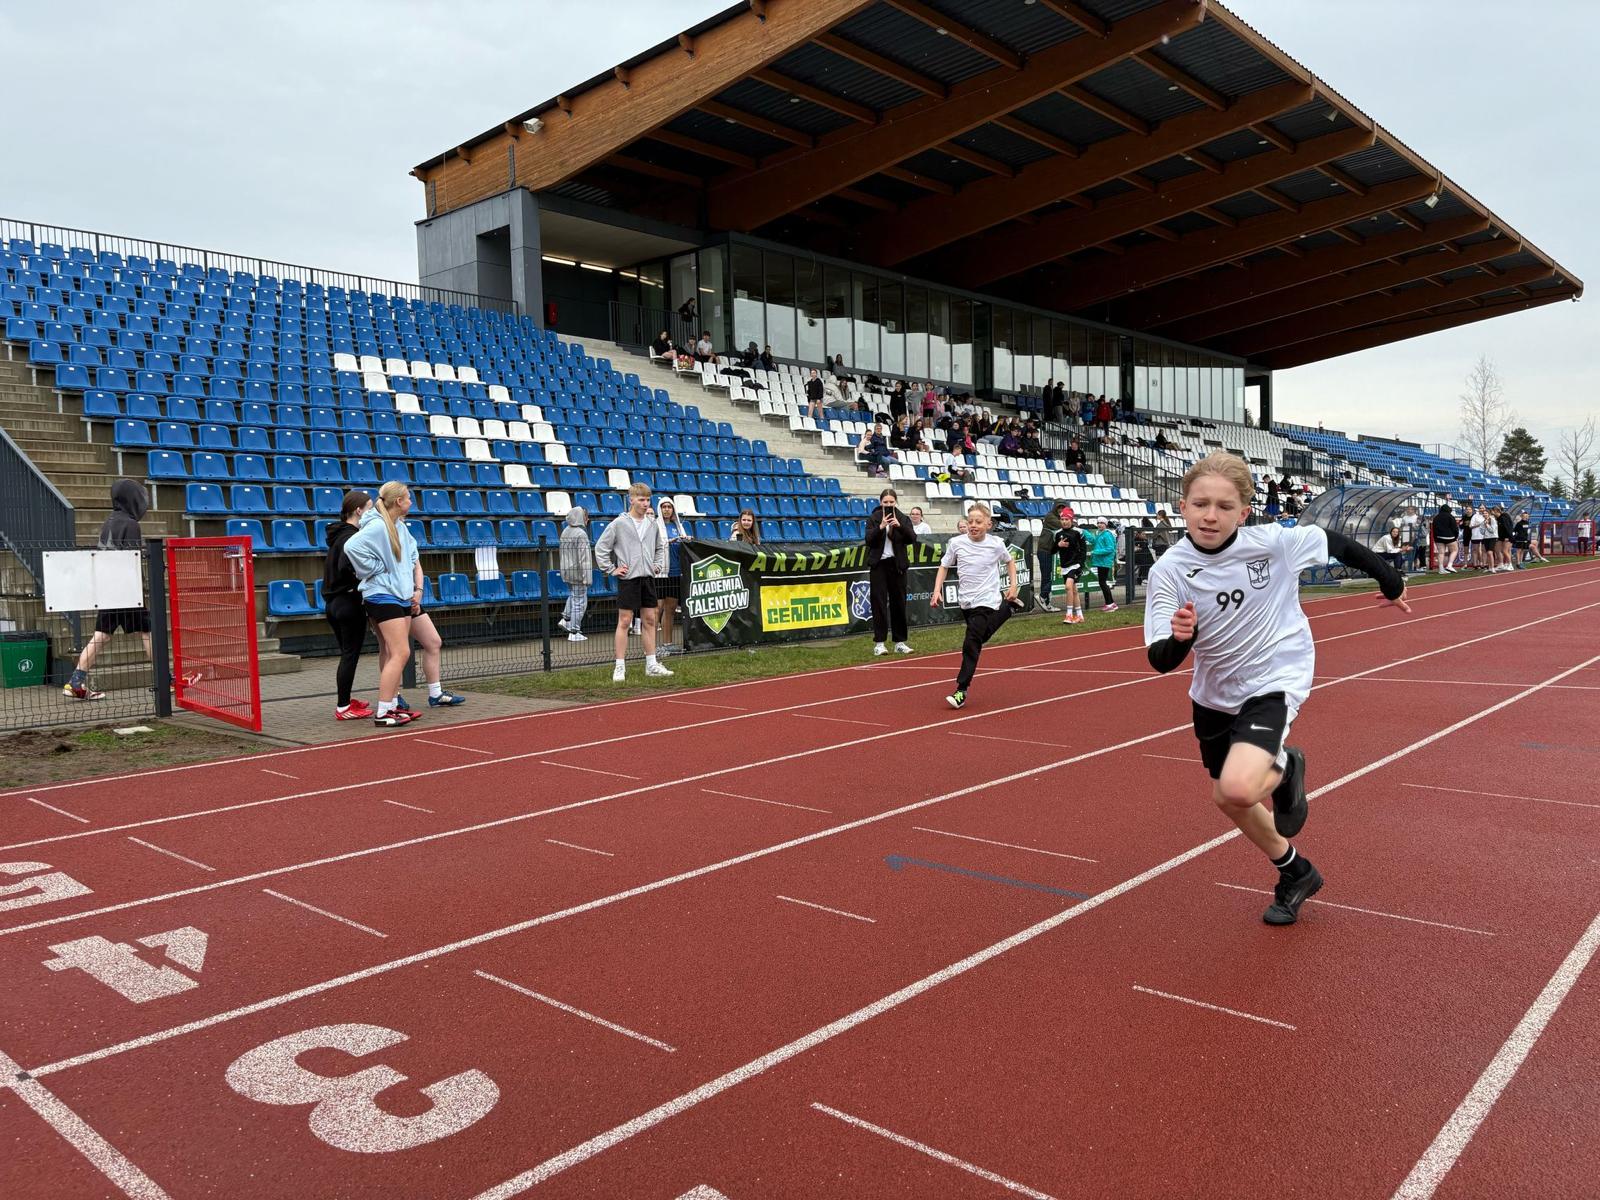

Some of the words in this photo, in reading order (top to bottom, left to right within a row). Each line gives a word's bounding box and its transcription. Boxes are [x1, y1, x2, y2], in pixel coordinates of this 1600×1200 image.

[749, 545, 866, 572] AKADEMI
[691, 578, 741, 597] AKADEMIA
[689, 591, 748, 615] TALENTÓW
[1216, 589, 1245, 612] 99
[41, 925, 209, 1004] 4
[224, 1023, 501, 1155] 3
